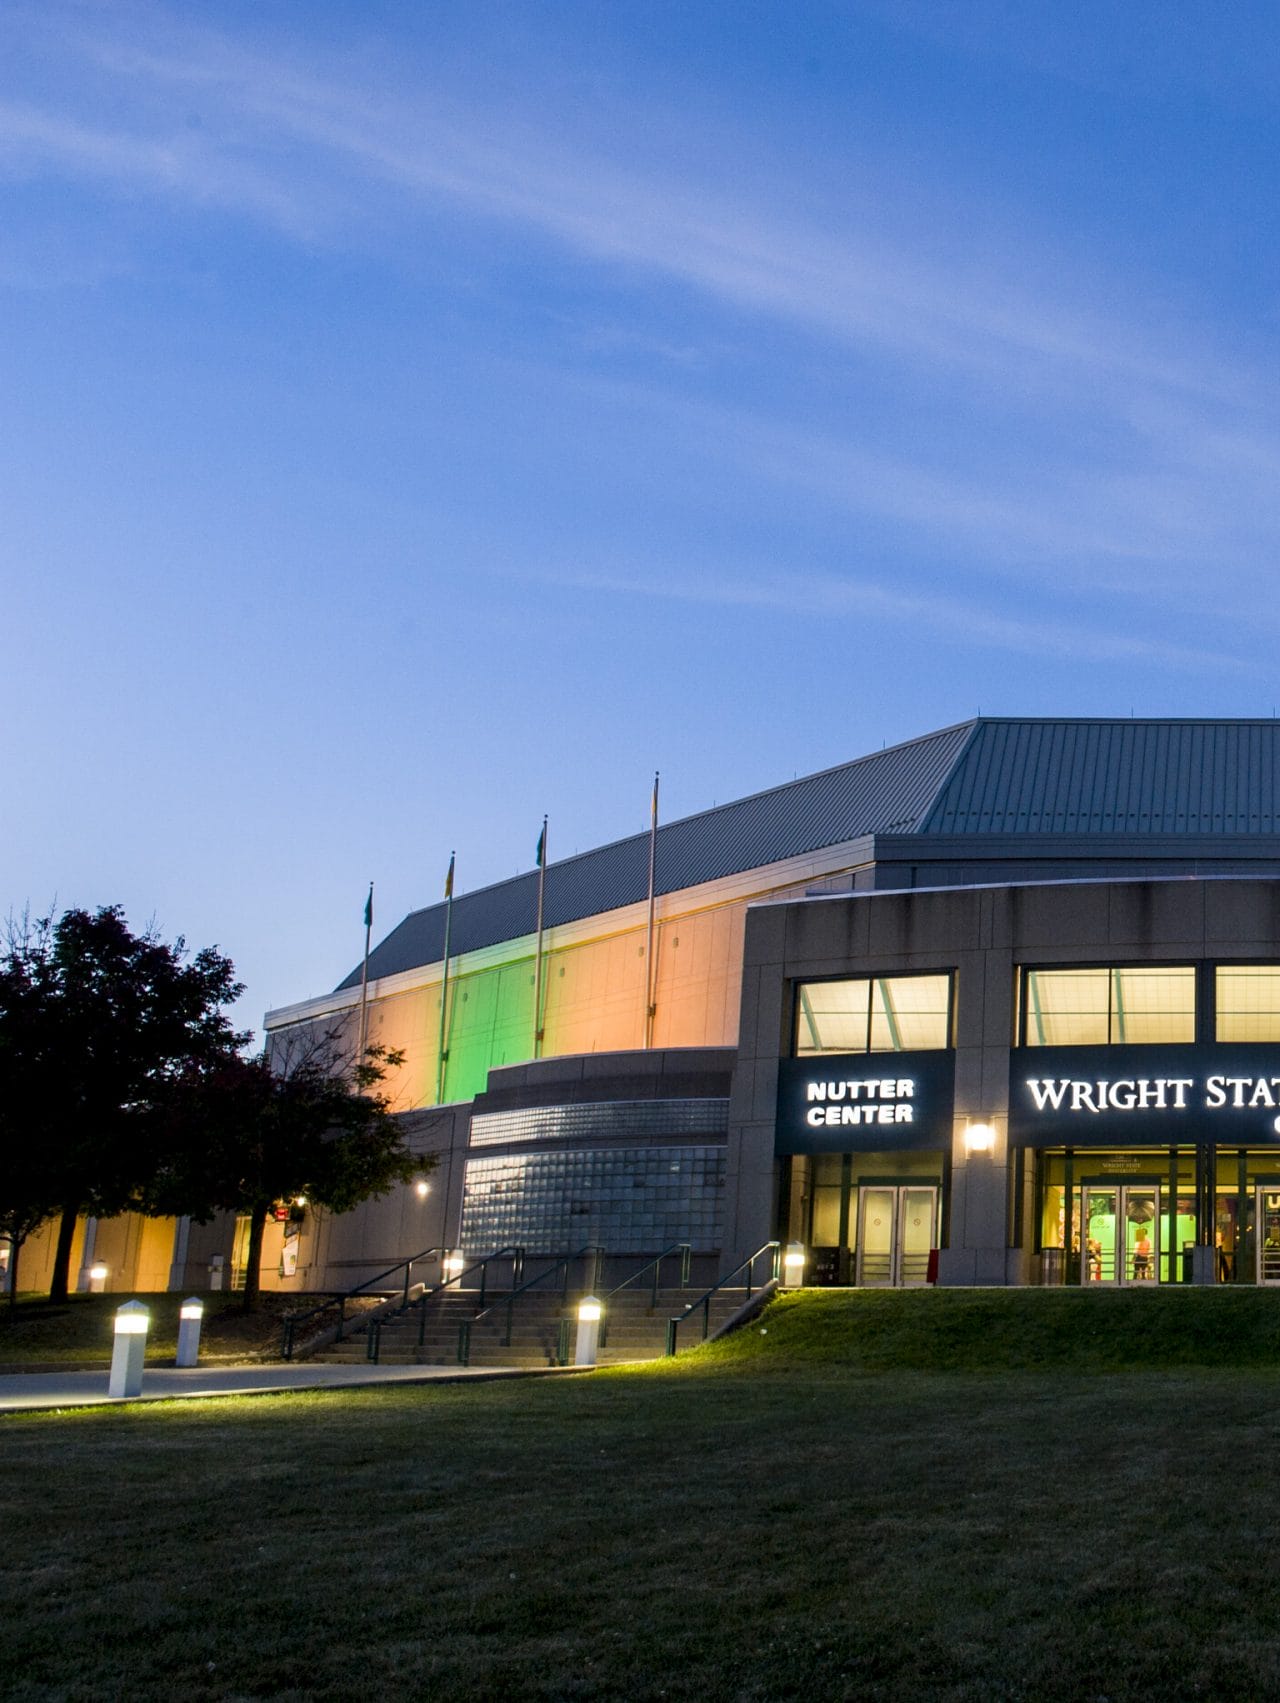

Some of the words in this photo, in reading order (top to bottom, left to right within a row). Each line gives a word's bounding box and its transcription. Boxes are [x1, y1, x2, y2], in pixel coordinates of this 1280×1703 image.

[807, 1079, 914, 1101] NUTTER
[1026, 1079, 1193, 1113] WRIGHT
[807, 1104, 913, 1126] CENTER
